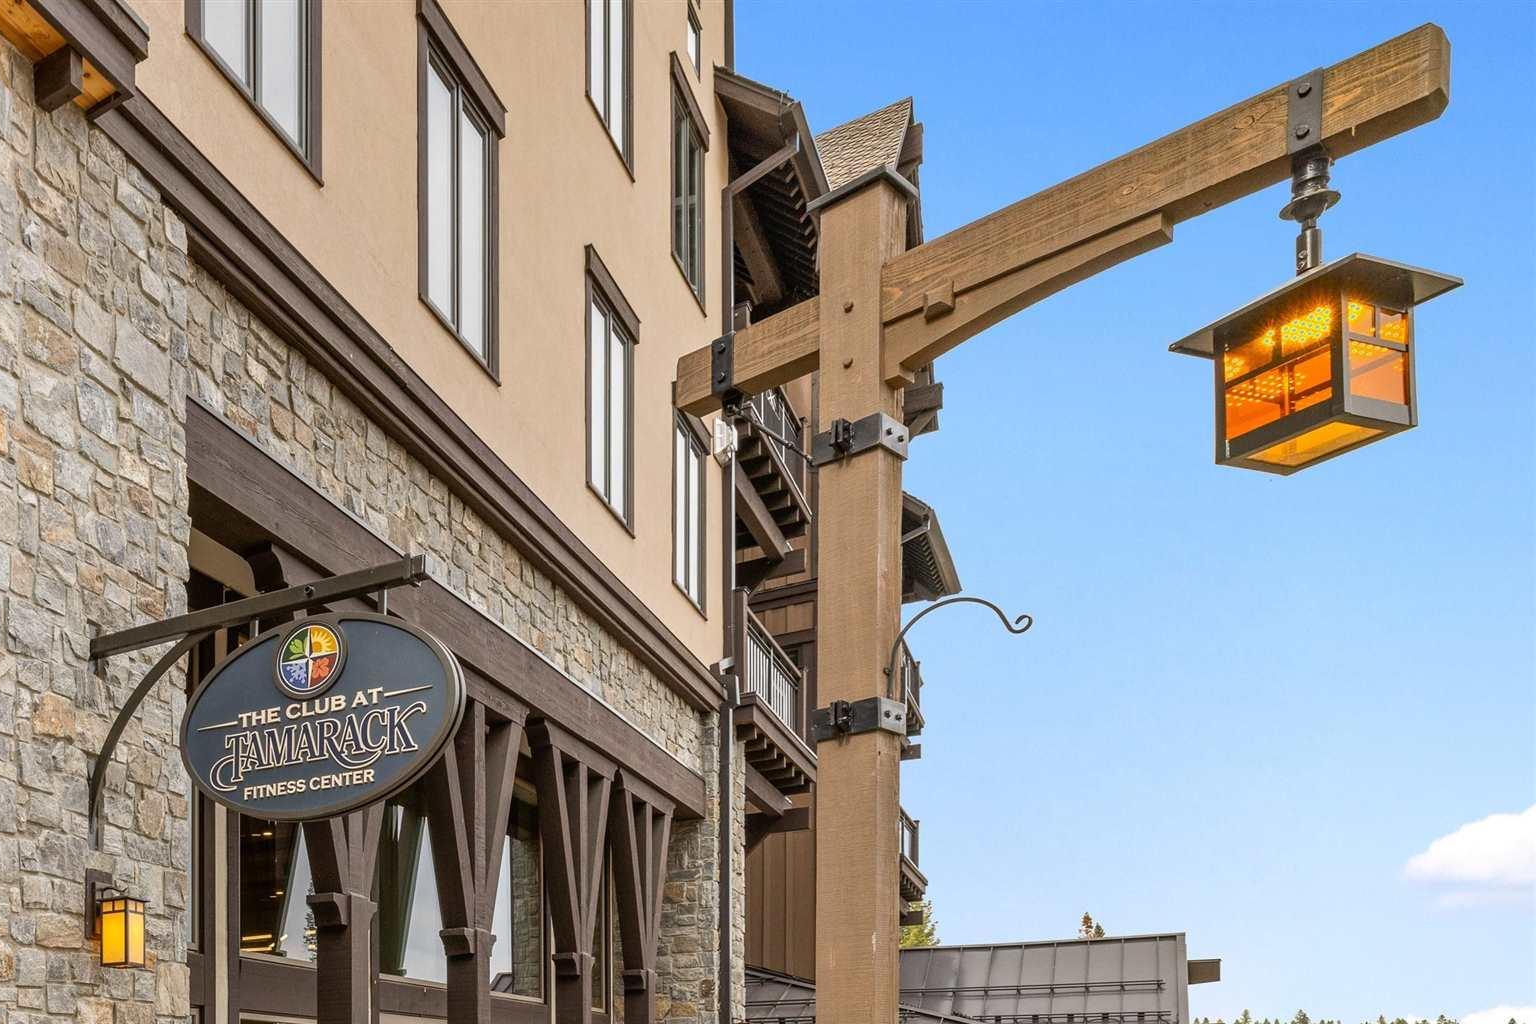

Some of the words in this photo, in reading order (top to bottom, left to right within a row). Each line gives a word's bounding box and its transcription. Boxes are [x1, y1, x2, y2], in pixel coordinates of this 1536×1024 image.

[238, 706, 282, 729] THE
[285, 695, 347, 721] CLUB
[351, 686, 384, 708] AT
[210, 701, 427, 792] TAMARACK
[243, 779, 307, 801] FITNESS
[309, 768, 375, 791] CENTER
